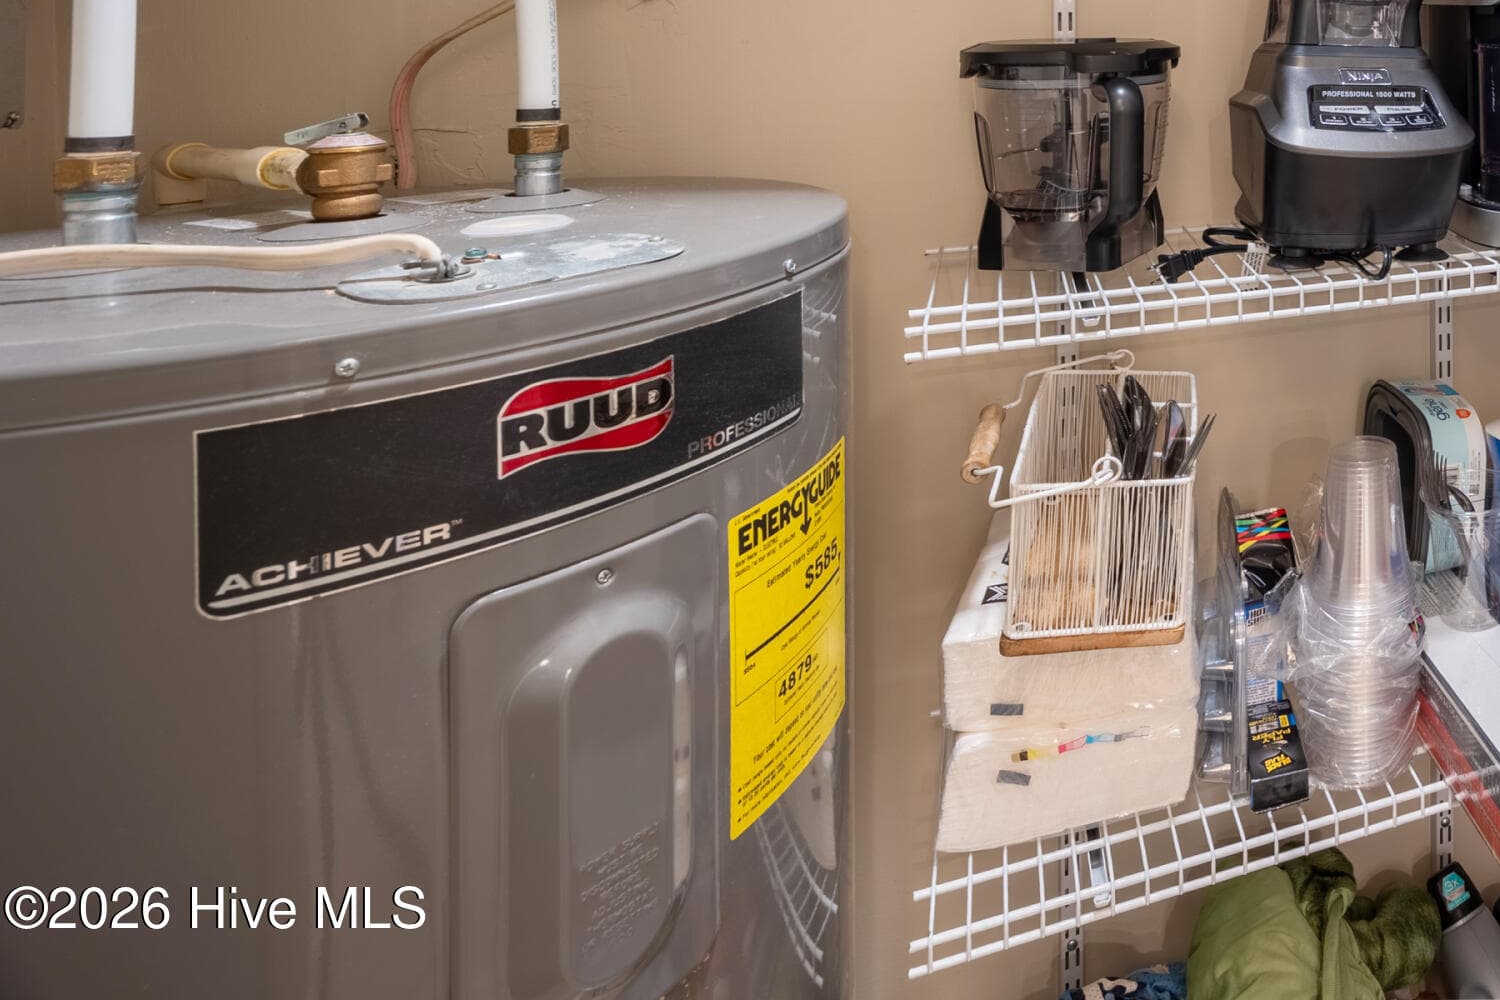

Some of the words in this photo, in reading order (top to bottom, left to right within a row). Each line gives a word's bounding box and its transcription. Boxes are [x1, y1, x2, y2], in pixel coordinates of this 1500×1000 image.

[1322, 90, 1374, 98] PROFESSIONAL
[1346, 70, 1384, 82] NINJA
[500, 374, 673, 458] RUUD
[688, 393, 801, 459] PROFESSIONAL
[738, 451, 841, 556] ENERGYGUIDE
[805, 537, 838, 591] $585
[778, 654, 812, 697] 4879
